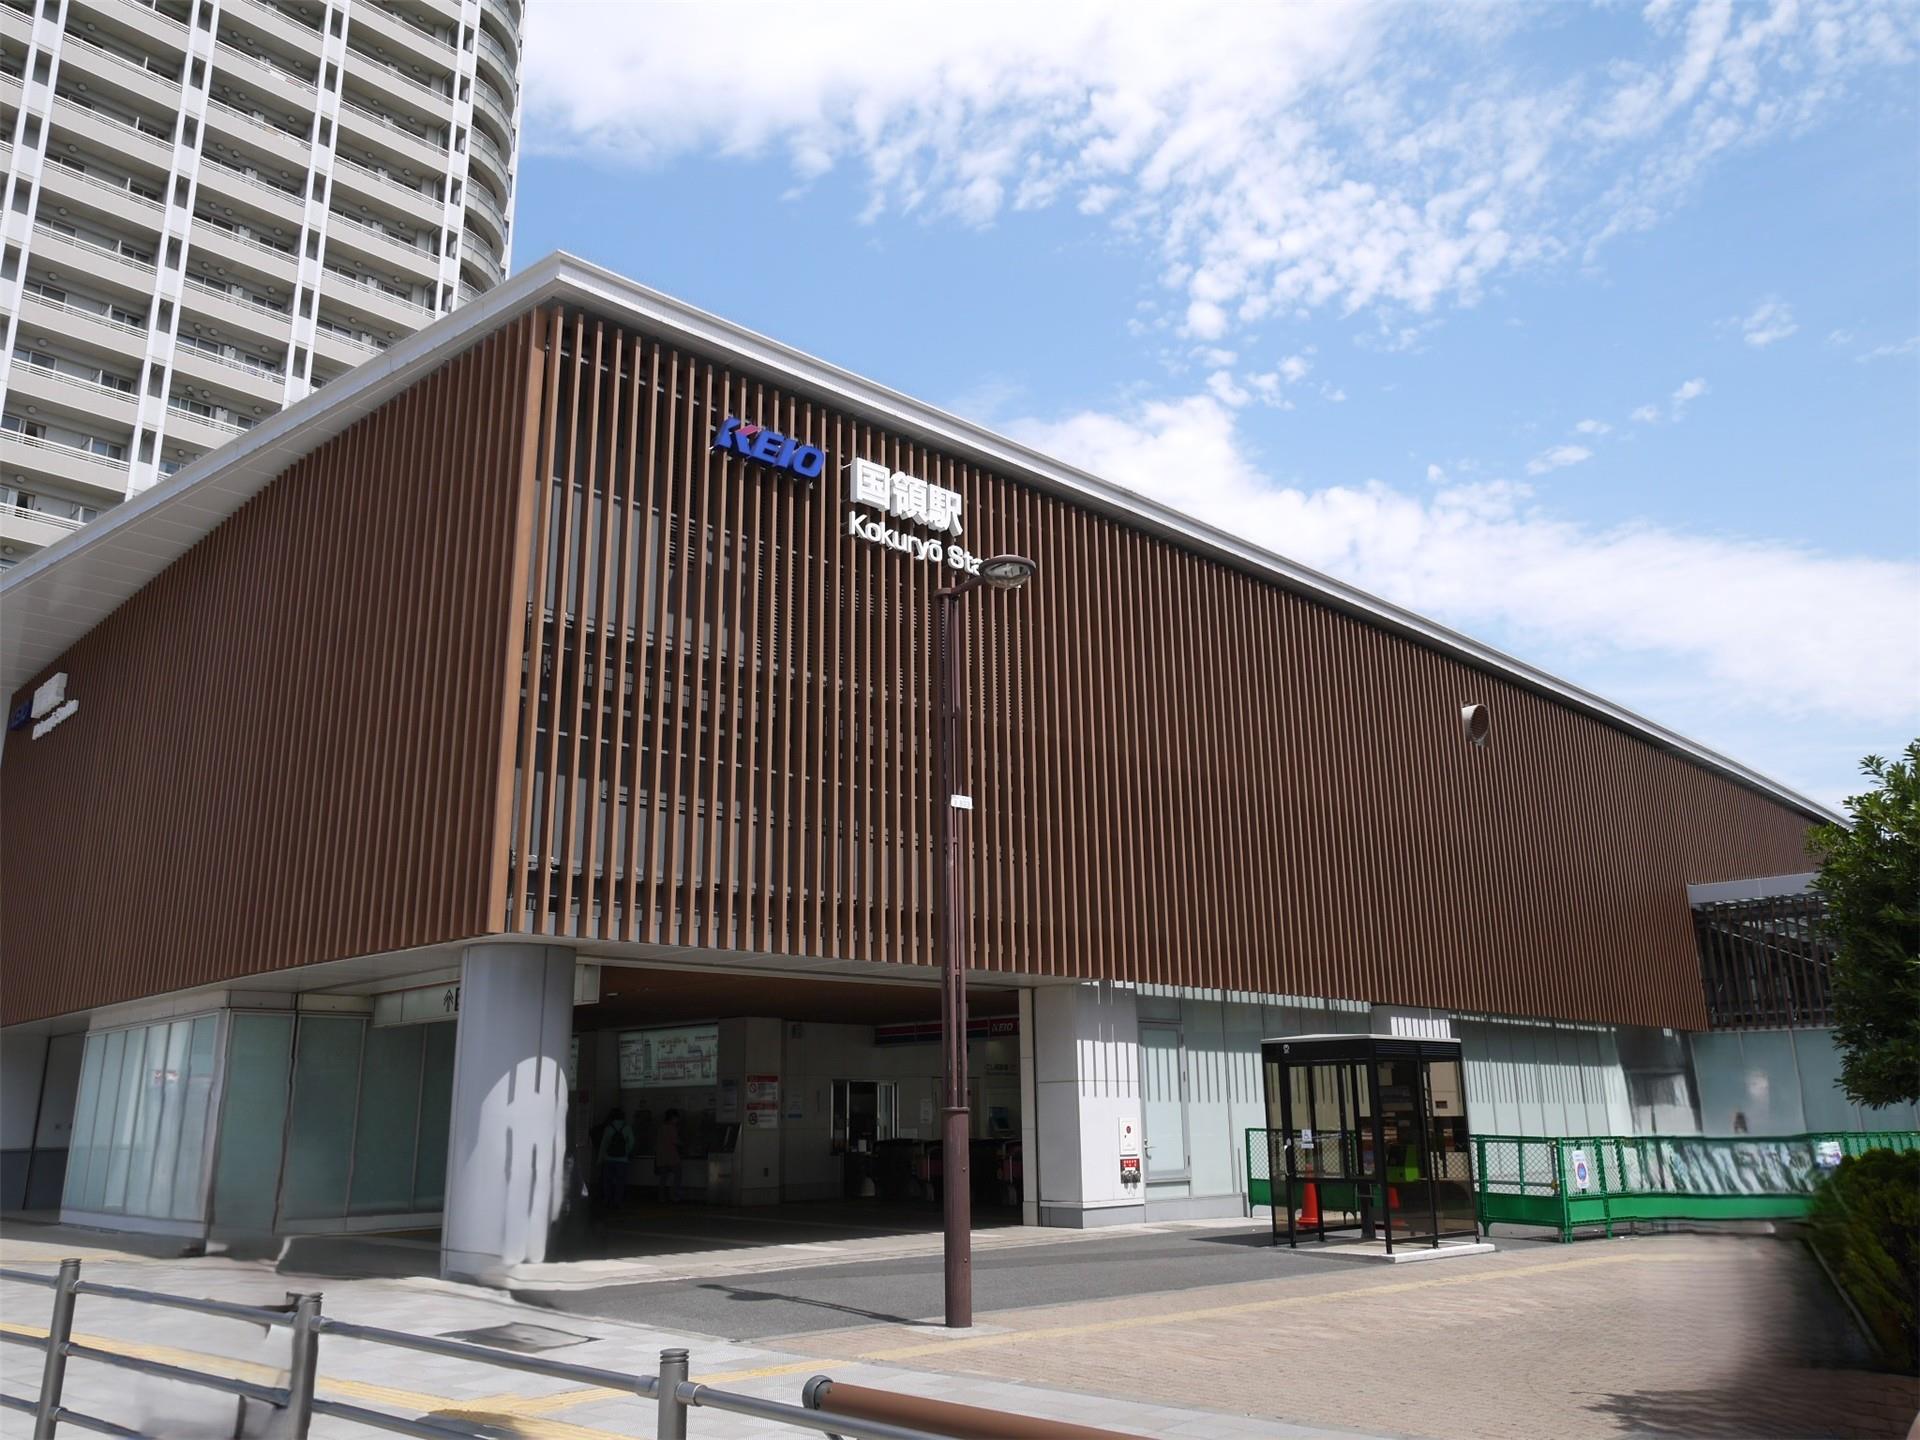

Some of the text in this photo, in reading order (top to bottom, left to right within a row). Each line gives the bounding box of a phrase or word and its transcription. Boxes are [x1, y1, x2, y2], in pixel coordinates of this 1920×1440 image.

[714, 416, 825, 478] KEIO
[850, 457, 963, 537] 国領駅
[849, 511, 984, 576] Kokuryō Sta
